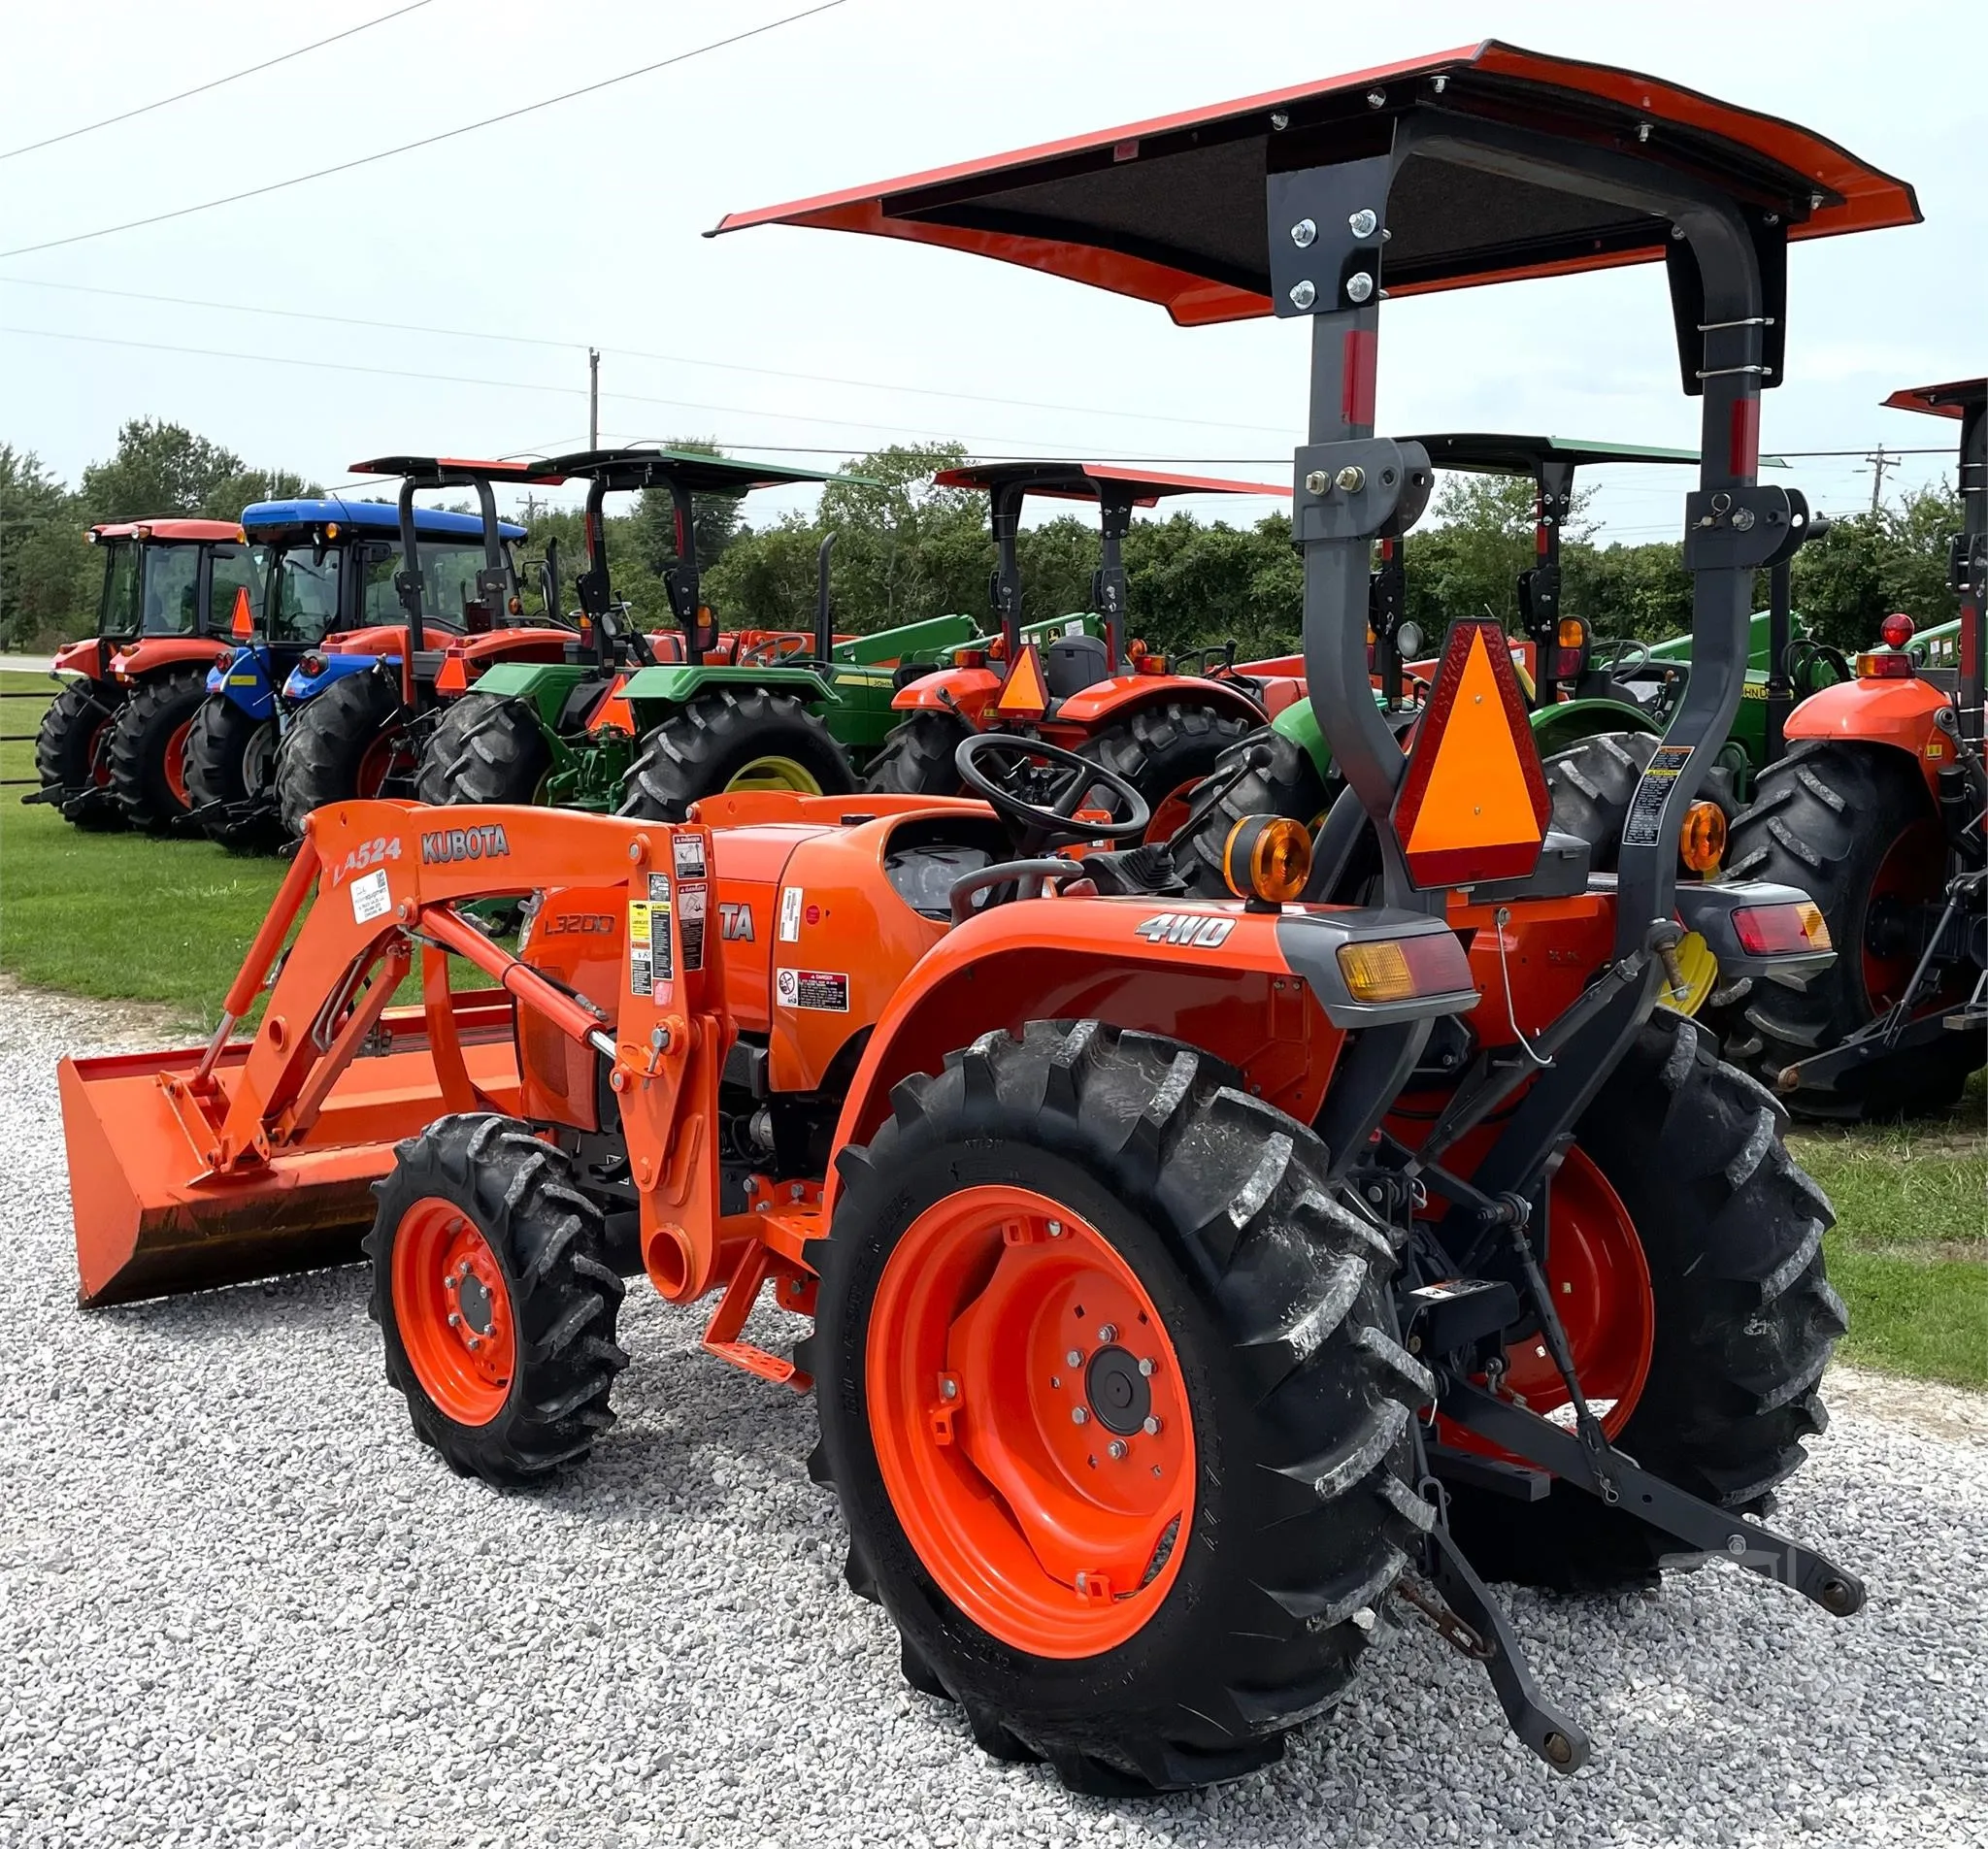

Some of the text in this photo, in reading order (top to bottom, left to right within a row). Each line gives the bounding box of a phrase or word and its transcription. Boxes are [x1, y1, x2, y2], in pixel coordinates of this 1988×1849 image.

[421, 824, 510, 865] KUBOTA
[545, 913, 615, 936] L3200
[1135, 911, 1238, 948] 4WD
